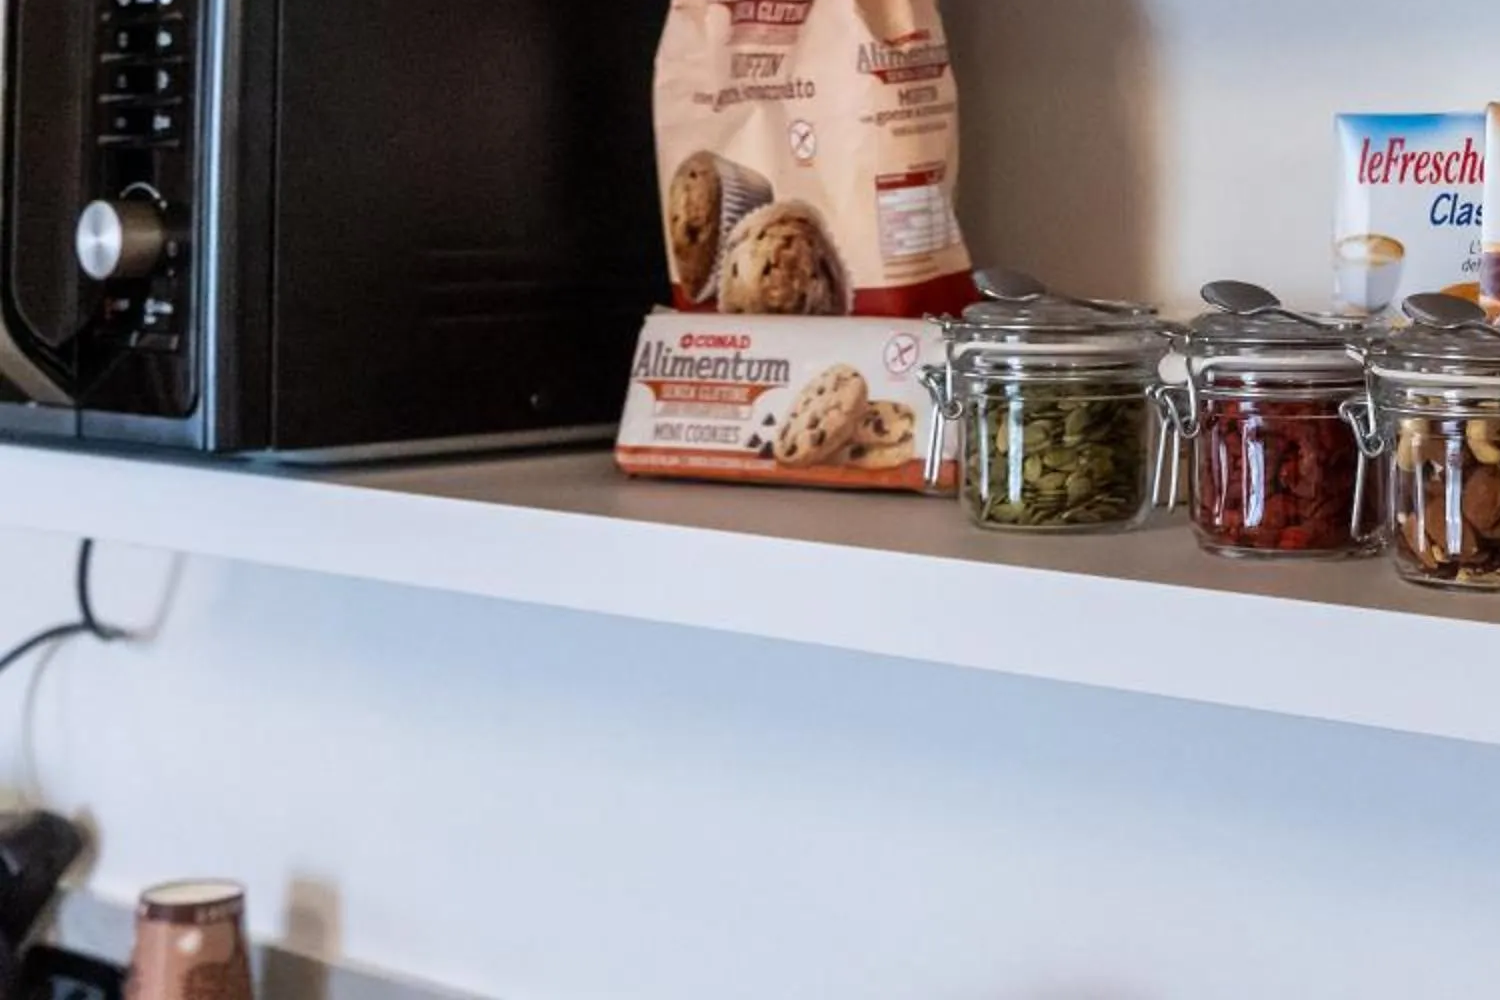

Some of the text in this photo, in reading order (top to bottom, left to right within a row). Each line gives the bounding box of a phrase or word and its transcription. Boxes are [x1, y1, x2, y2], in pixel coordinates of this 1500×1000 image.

[1358, 136, 1485, 185] leFresch
[695, 334, 752, 349] CONAD
[632, 340, 790, 382] Alimentum
[686, 424, 741, 444] COOKIES
